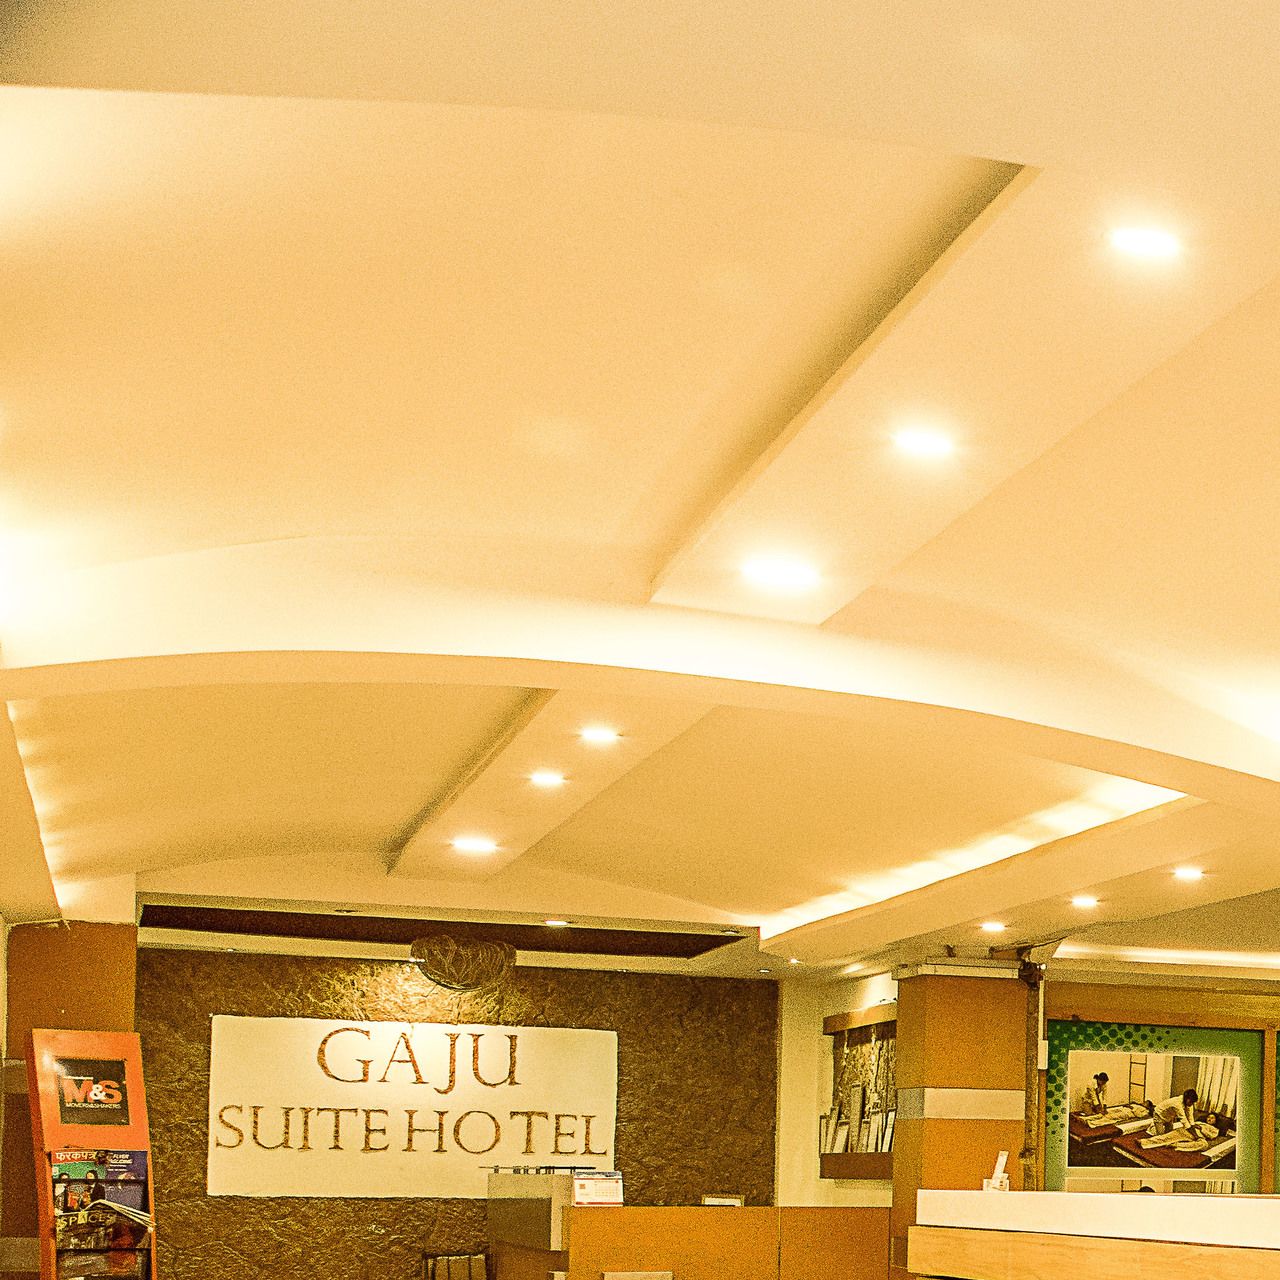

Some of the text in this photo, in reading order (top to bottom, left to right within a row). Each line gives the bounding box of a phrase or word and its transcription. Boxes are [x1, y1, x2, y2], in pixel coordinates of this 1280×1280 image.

[316, 1026, 522, 1095] GAJU
[61, 1079, 122, 1104] M&S
[215, 1104, 608, 1156] SUITE HOTEL
